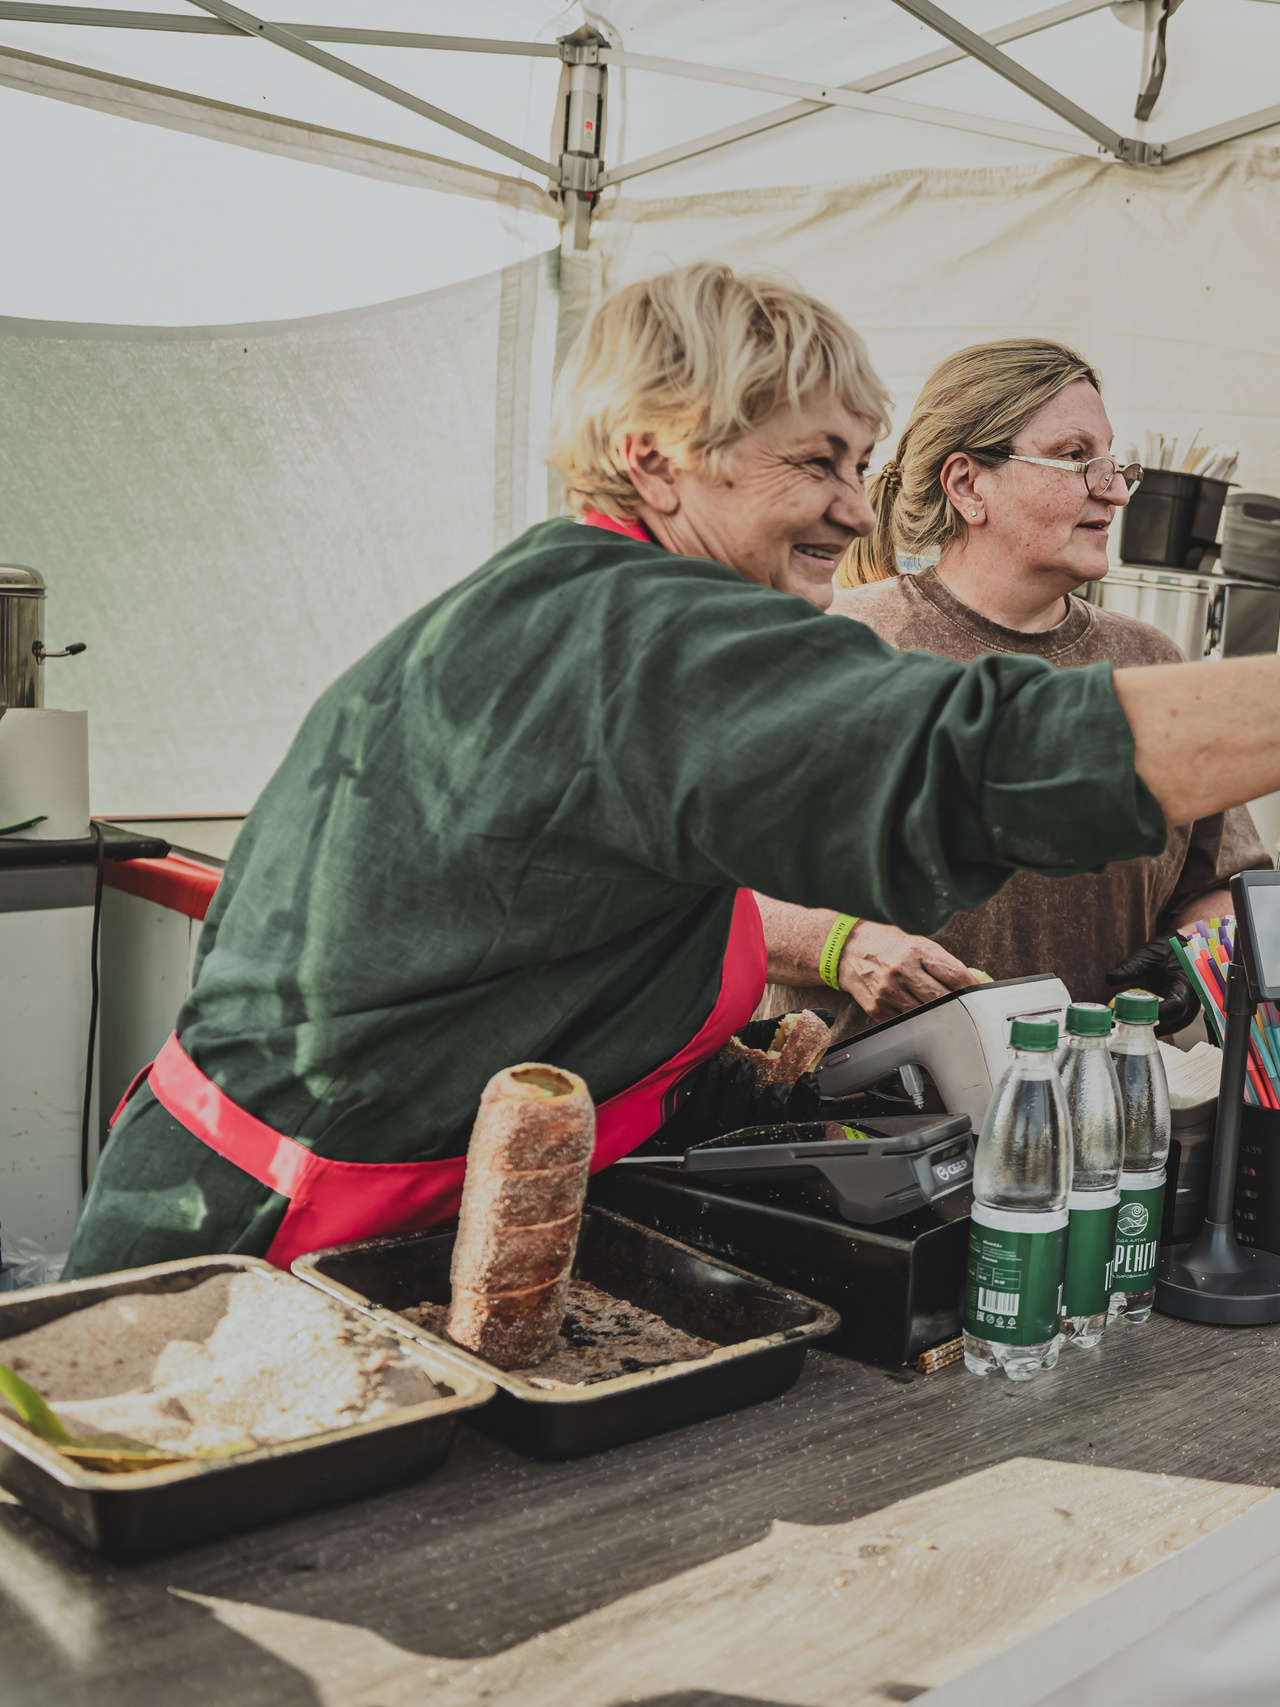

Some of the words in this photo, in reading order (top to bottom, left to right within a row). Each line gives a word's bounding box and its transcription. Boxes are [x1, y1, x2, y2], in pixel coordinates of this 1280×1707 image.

[947, 1159, 968, 1175] СБЕР
[1114, 1240, 1157, 1272] РЕНГИ
[1112, 1271, 1149, 1279] АЗИРОВАННАЯ
